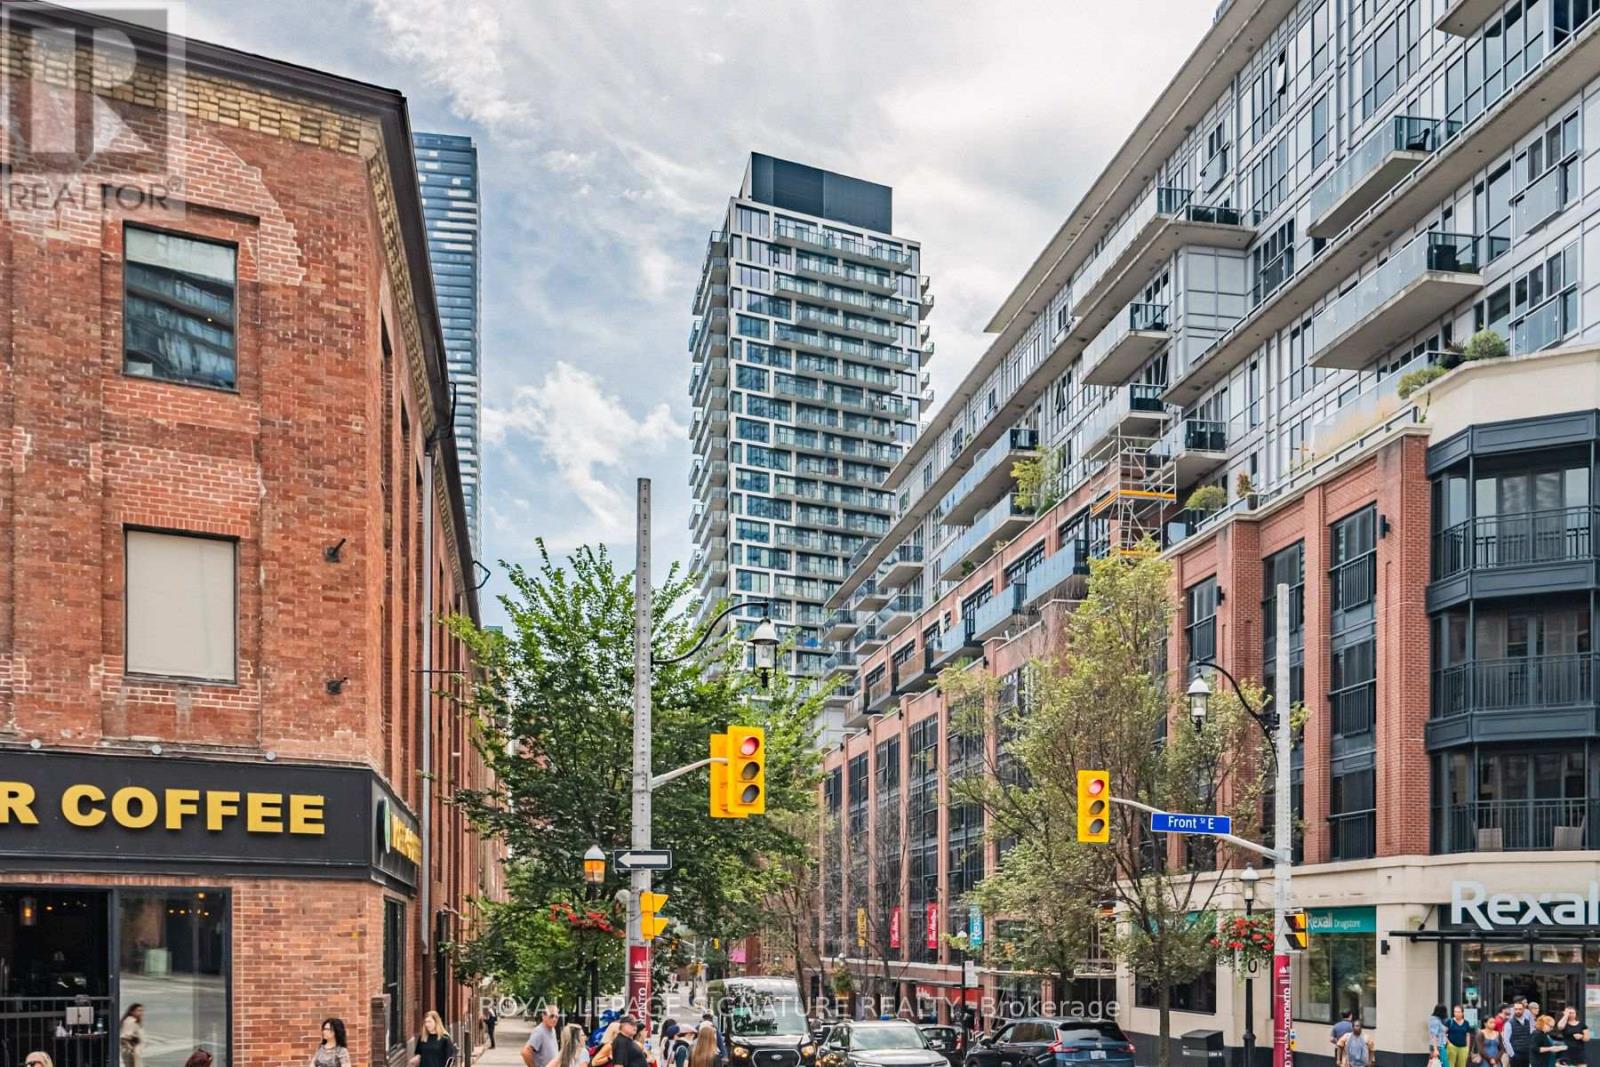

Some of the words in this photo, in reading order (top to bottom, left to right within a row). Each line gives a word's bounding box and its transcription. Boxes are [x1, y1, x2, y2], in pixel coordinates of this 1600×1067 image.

[61, 784, 325, 834] COFFEE
[1168, 815, 1197, 829] Front
[1207, 818, 1215, 829] E
[1451, 880, 1600, 930] Rexal
